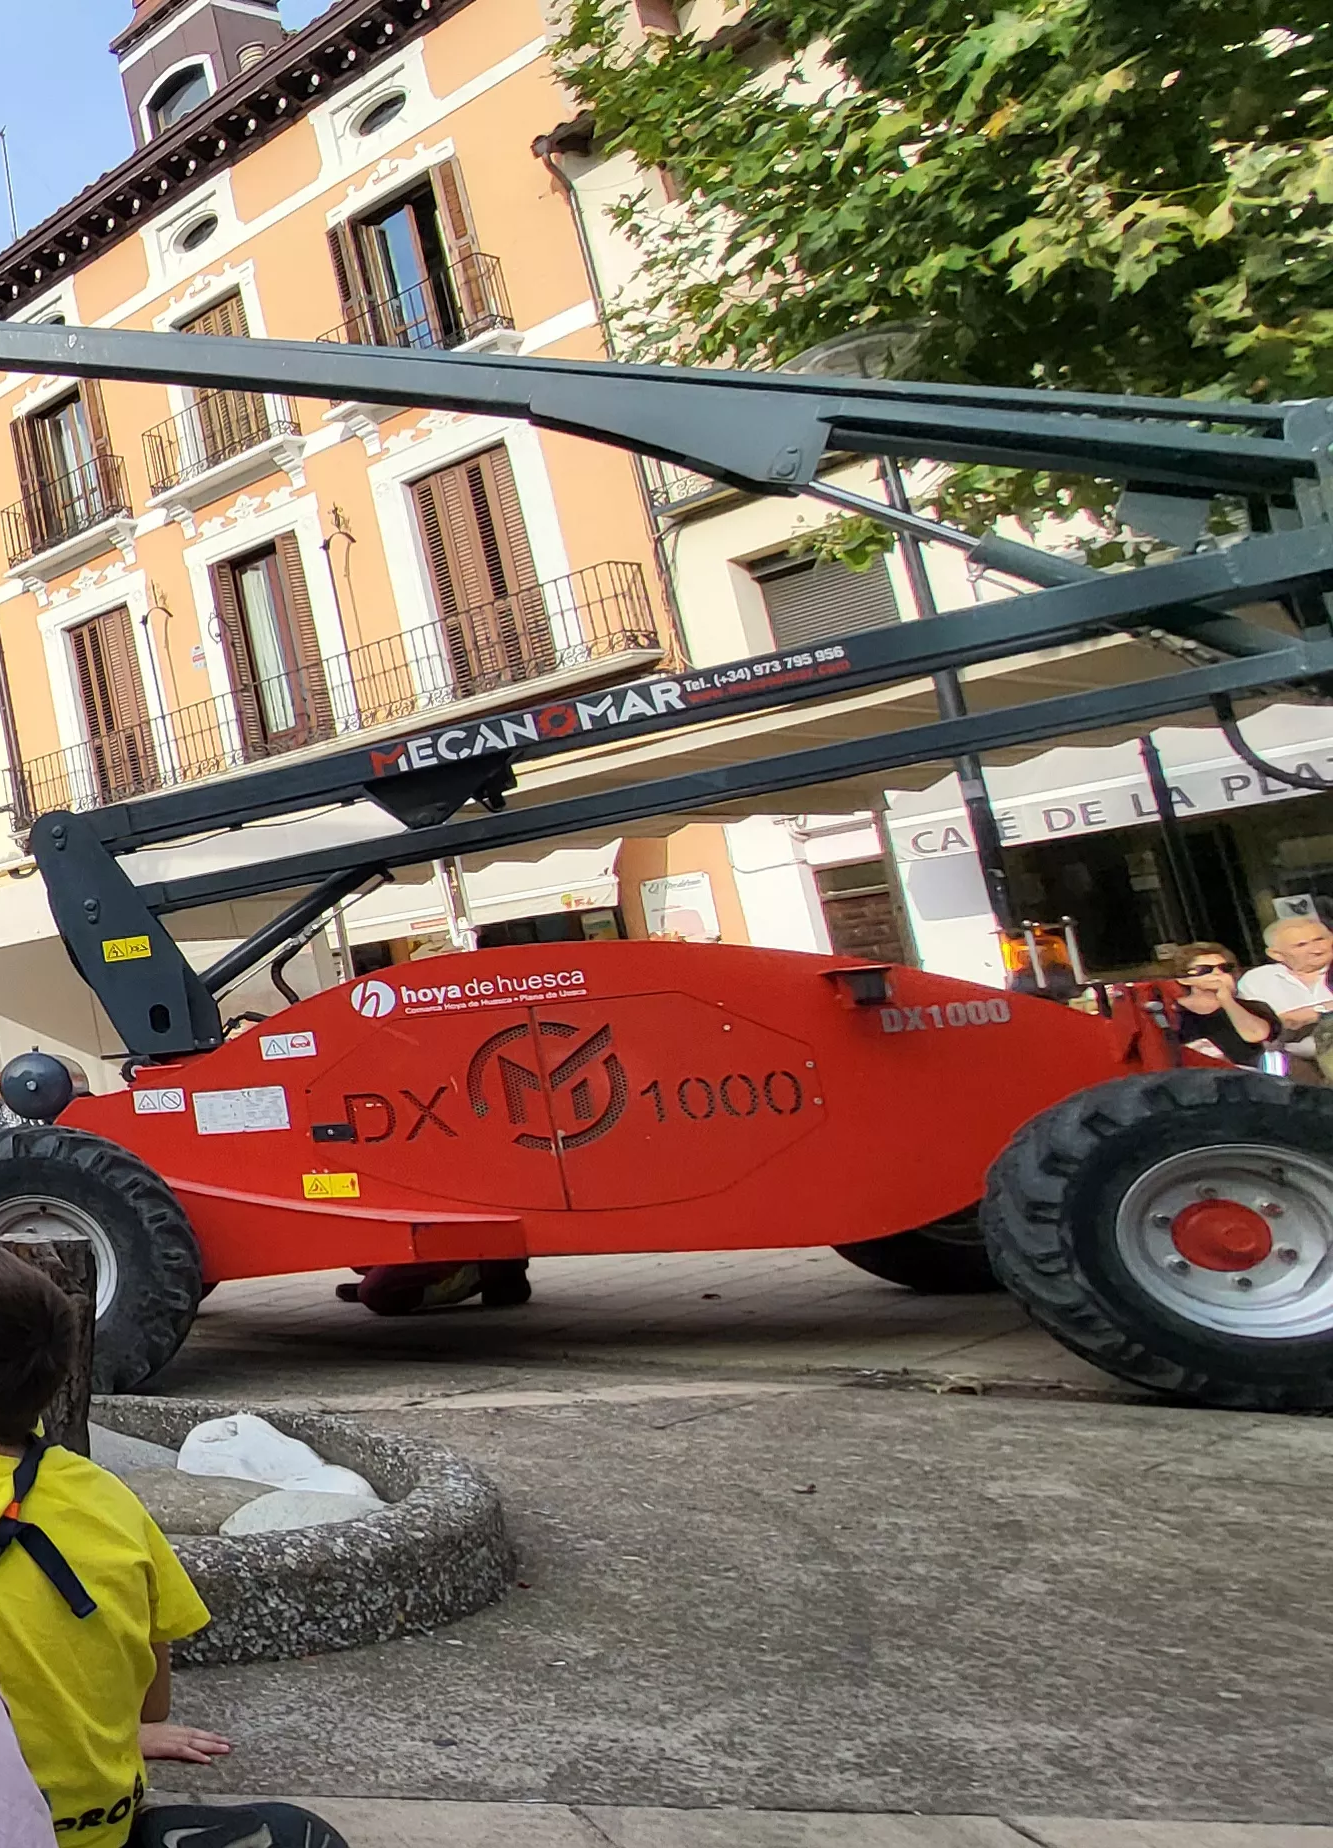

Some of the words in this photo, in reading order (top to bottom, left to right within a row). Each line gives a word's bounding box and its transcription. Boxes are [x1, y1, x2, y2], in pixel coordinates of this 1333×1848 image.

[683, 680, 711, 692] Tel.
[714, 668, 751, 687] (+34)
[753, 660, 782, 676] 973
[783, 653, 813, 669] 795
[814, 645, 845, 662] 956
[369, 680, 686, 778] MECANOMAR
[910, 811, 1022, 854] CAÉ
[1041, 800, 1107, 833] DE
[1130, 784, 1196, 818] LA
[1220, 757, 1333, 802] PLA
[399, 983, 462, 1004] hoya
[464, 980, 494, 996] de
[496, 969, 585, 993] huesca
[880, 998, 1011, 1033] DX1000
[343, 1085, 459, 1144] DX
[640, 1070, 803, 1123] 1000
